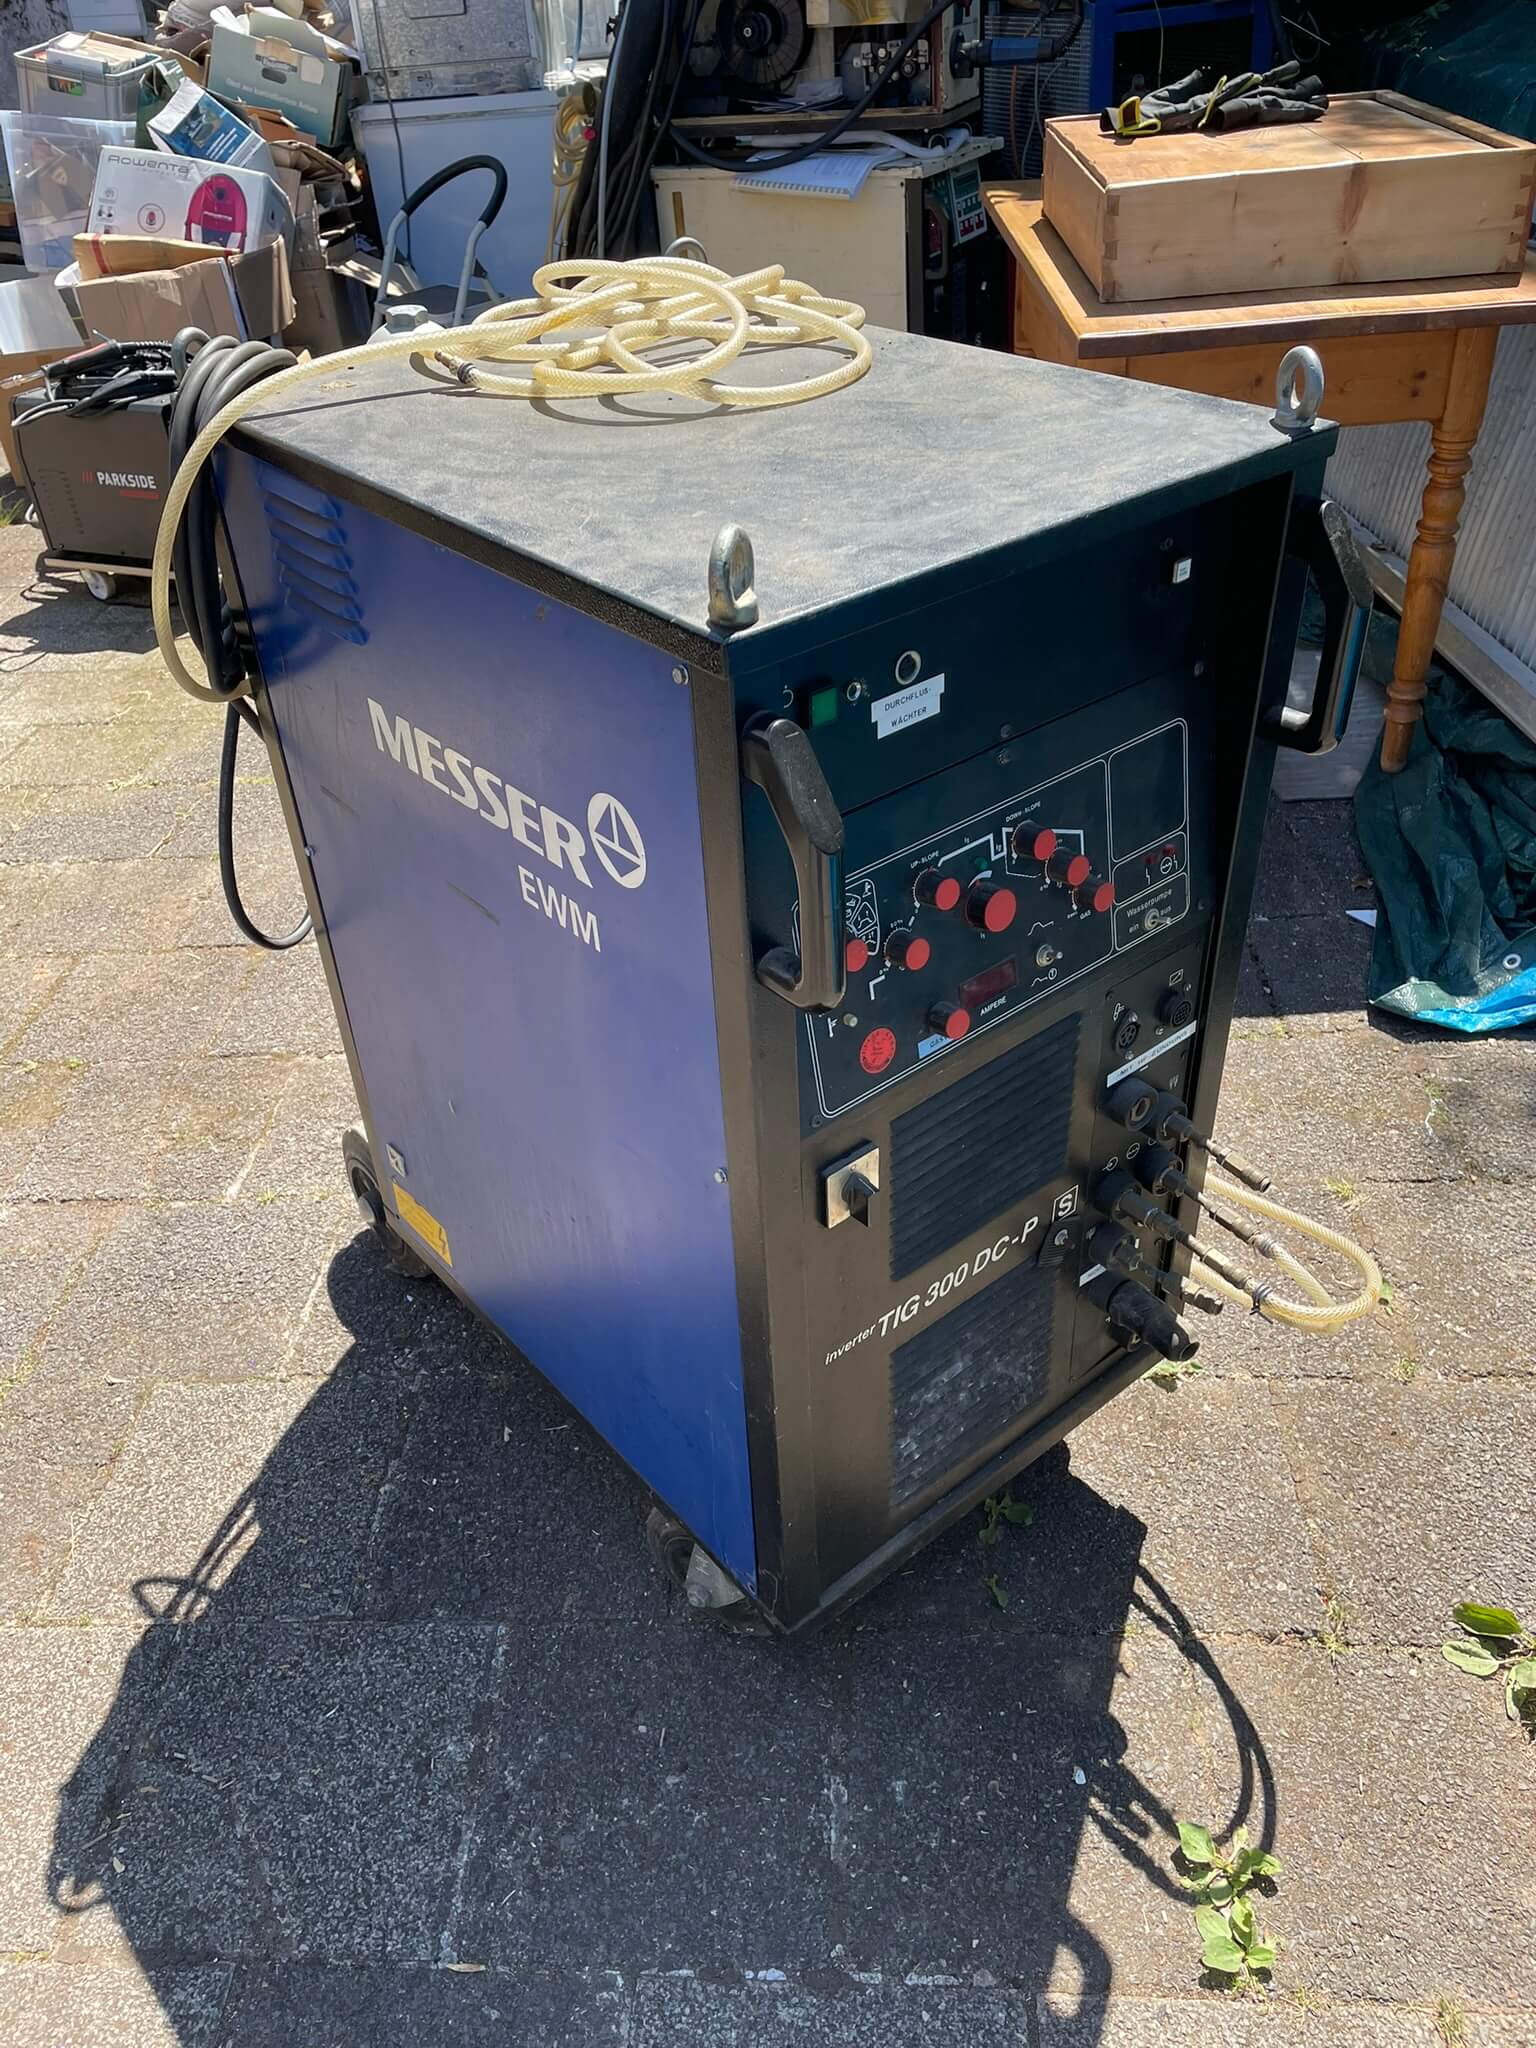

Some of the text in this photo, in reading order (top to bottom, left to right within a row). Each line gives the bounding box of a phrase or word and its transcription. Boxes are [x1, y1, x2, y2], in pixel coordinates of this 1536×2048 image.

[97, 471, 156, 489] PARKSIDE
[367, 697, 594, 889] MESSER
[518, 864, 601, 953] EWM
[980, 995, 1007, 1017] AMPERE
[825, 1324, 875, 1365] inverter
[878, 1294, 922, 1337] TIG
[924, 1262, 969, 1308] 300
[972, 1215, 1040, 1277] DC-P
